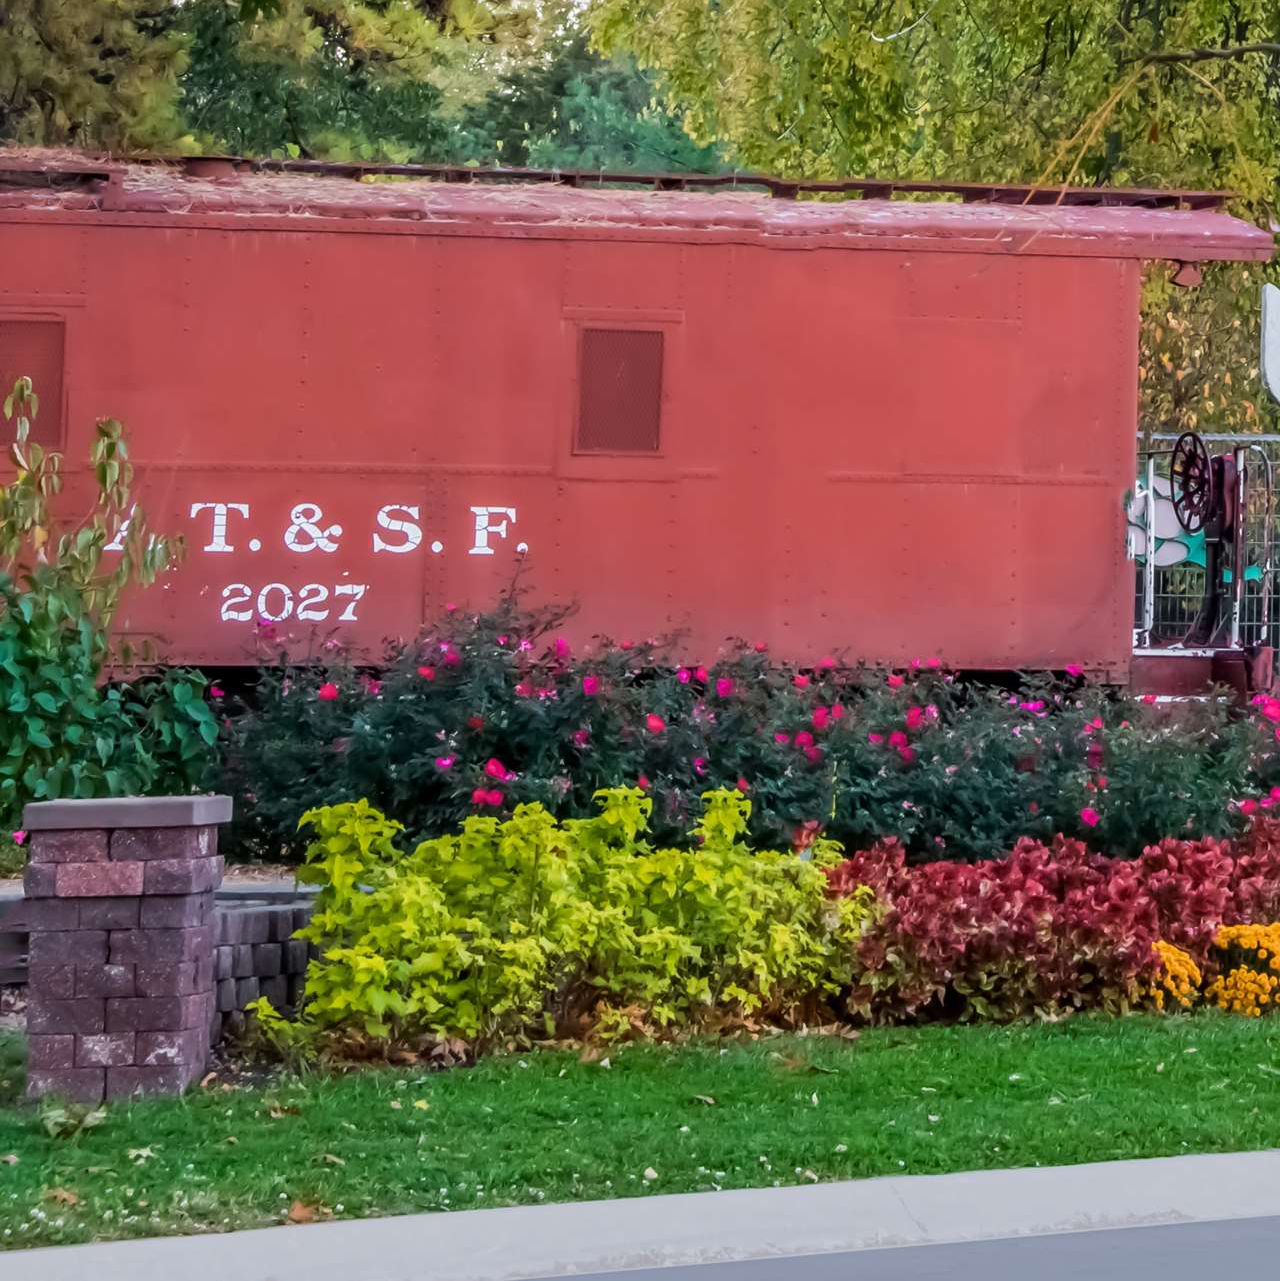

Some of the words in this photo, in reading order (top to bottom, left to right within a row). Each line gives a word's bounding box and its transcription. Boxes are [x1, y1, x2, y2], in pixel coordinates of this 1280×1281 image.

[190, 502, 262, 552] T.
[284, 502, 343, 553] &
[373, 504, 443, 553] S.
[468, 506, 528, 555] F.
[220, 583, 366, 622] 2027
